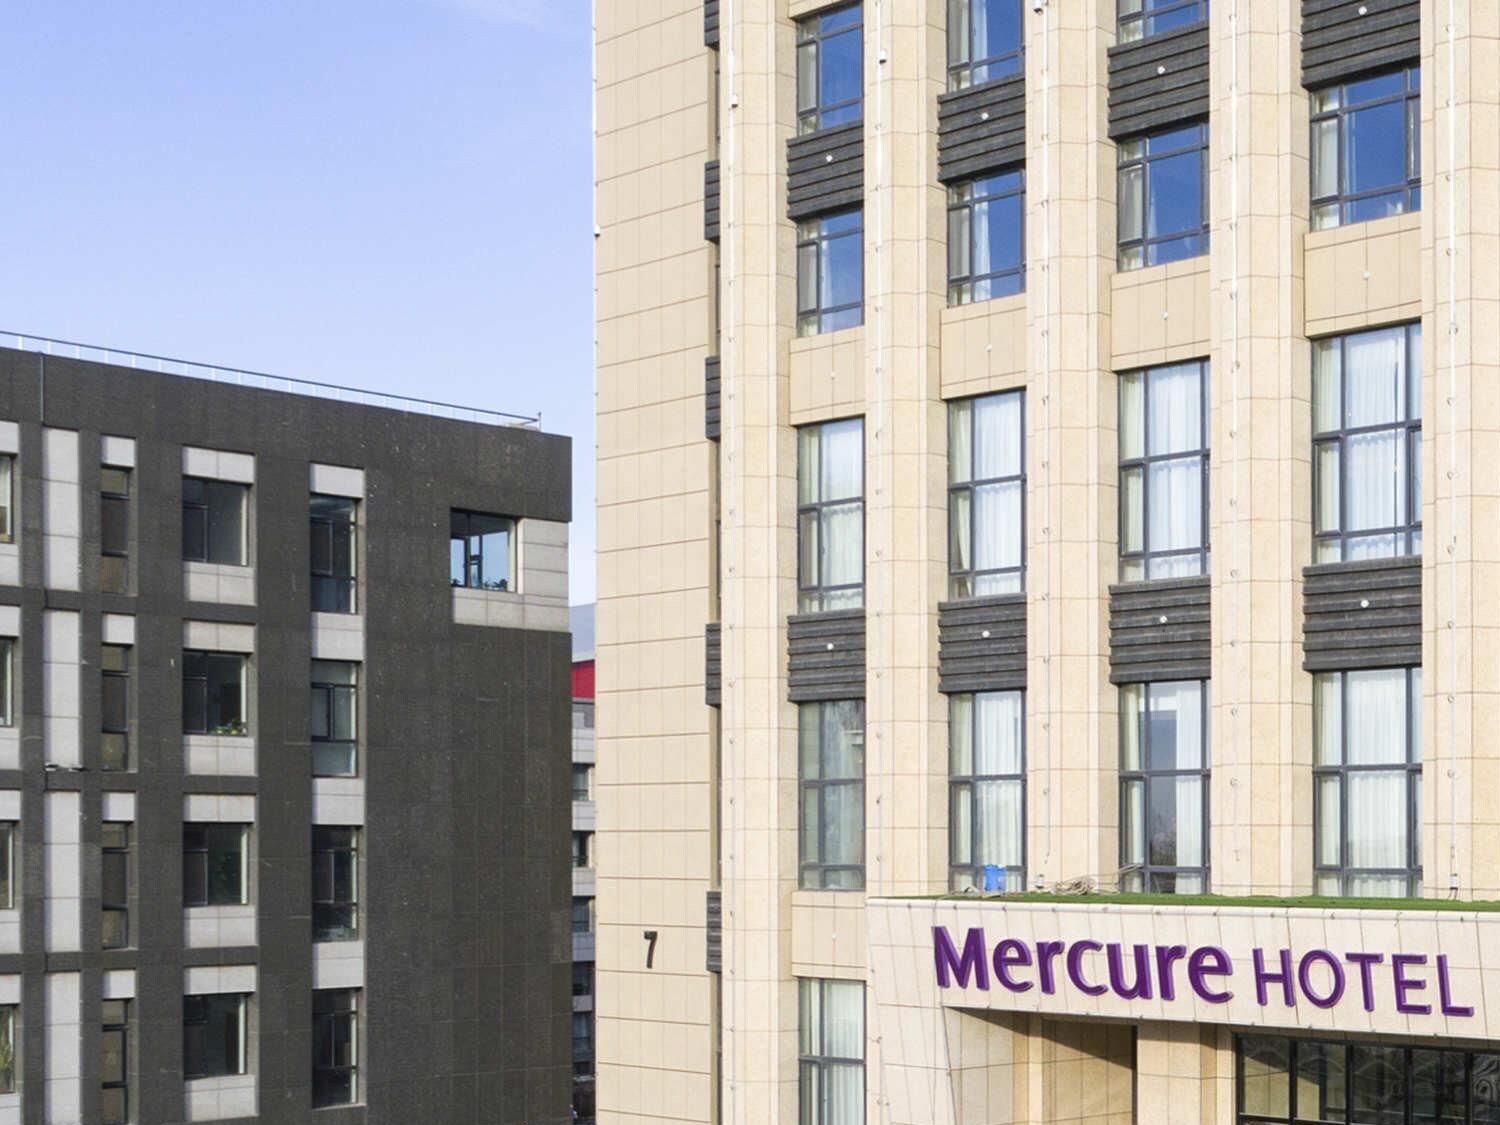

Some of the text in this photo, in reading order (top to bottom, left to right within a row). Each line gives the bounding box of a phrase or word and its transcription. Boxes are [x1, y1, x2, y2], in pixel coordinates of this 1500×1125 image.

[643, 930, 658, 969] 7
[932, 926, 1474, 1017] Mercure HOTEL
